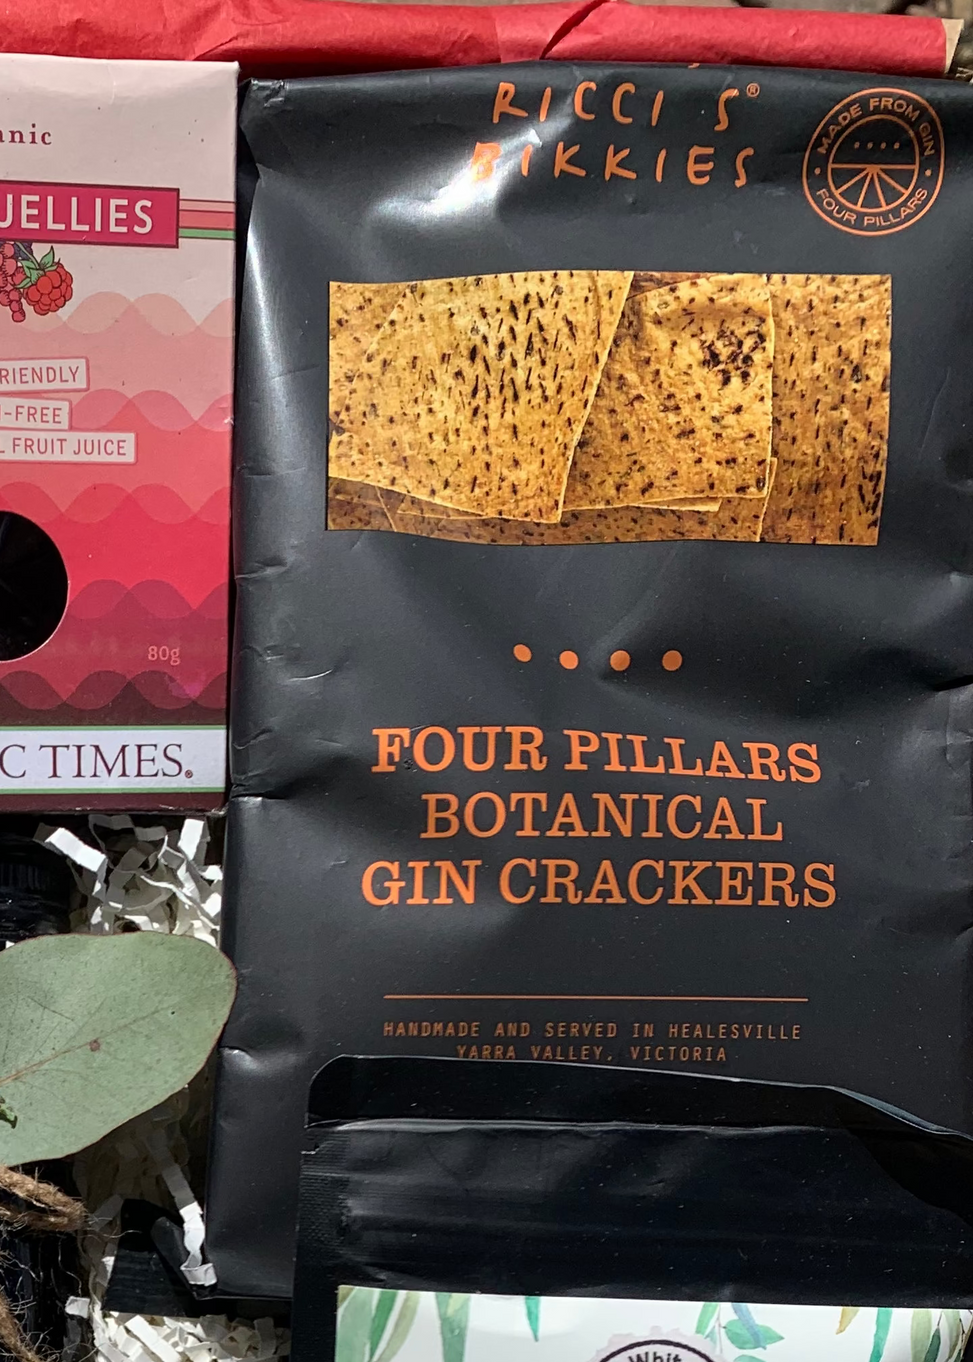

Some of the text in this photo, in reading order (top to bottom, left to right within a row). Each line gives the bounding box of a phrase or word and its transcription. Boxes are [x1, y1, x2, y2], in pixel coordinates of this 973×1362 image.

[817, 97, 935, 156] MADE FROM GIN
[471, 141, 754, 188] BIKKIES
[816, 188, 928, 227] FOUR PILLARS
[11, 436, 67, 455] FRUIT
[72, 438, 127, 456] JUICE
[147, 645, 181, 665] 80g
[371, 726, 822, 784] FOUR PILLARS
[419, 793, 784, 841] BOTANICAL
[361, 858, 837, 909] GIN CRACKERS
[383, 1021, 802, 1040] HANDMADE AND SERVED IN HEALESVILLE
[456, 1044, 727, 1062] YARRA VALLEY, VICTORIA
